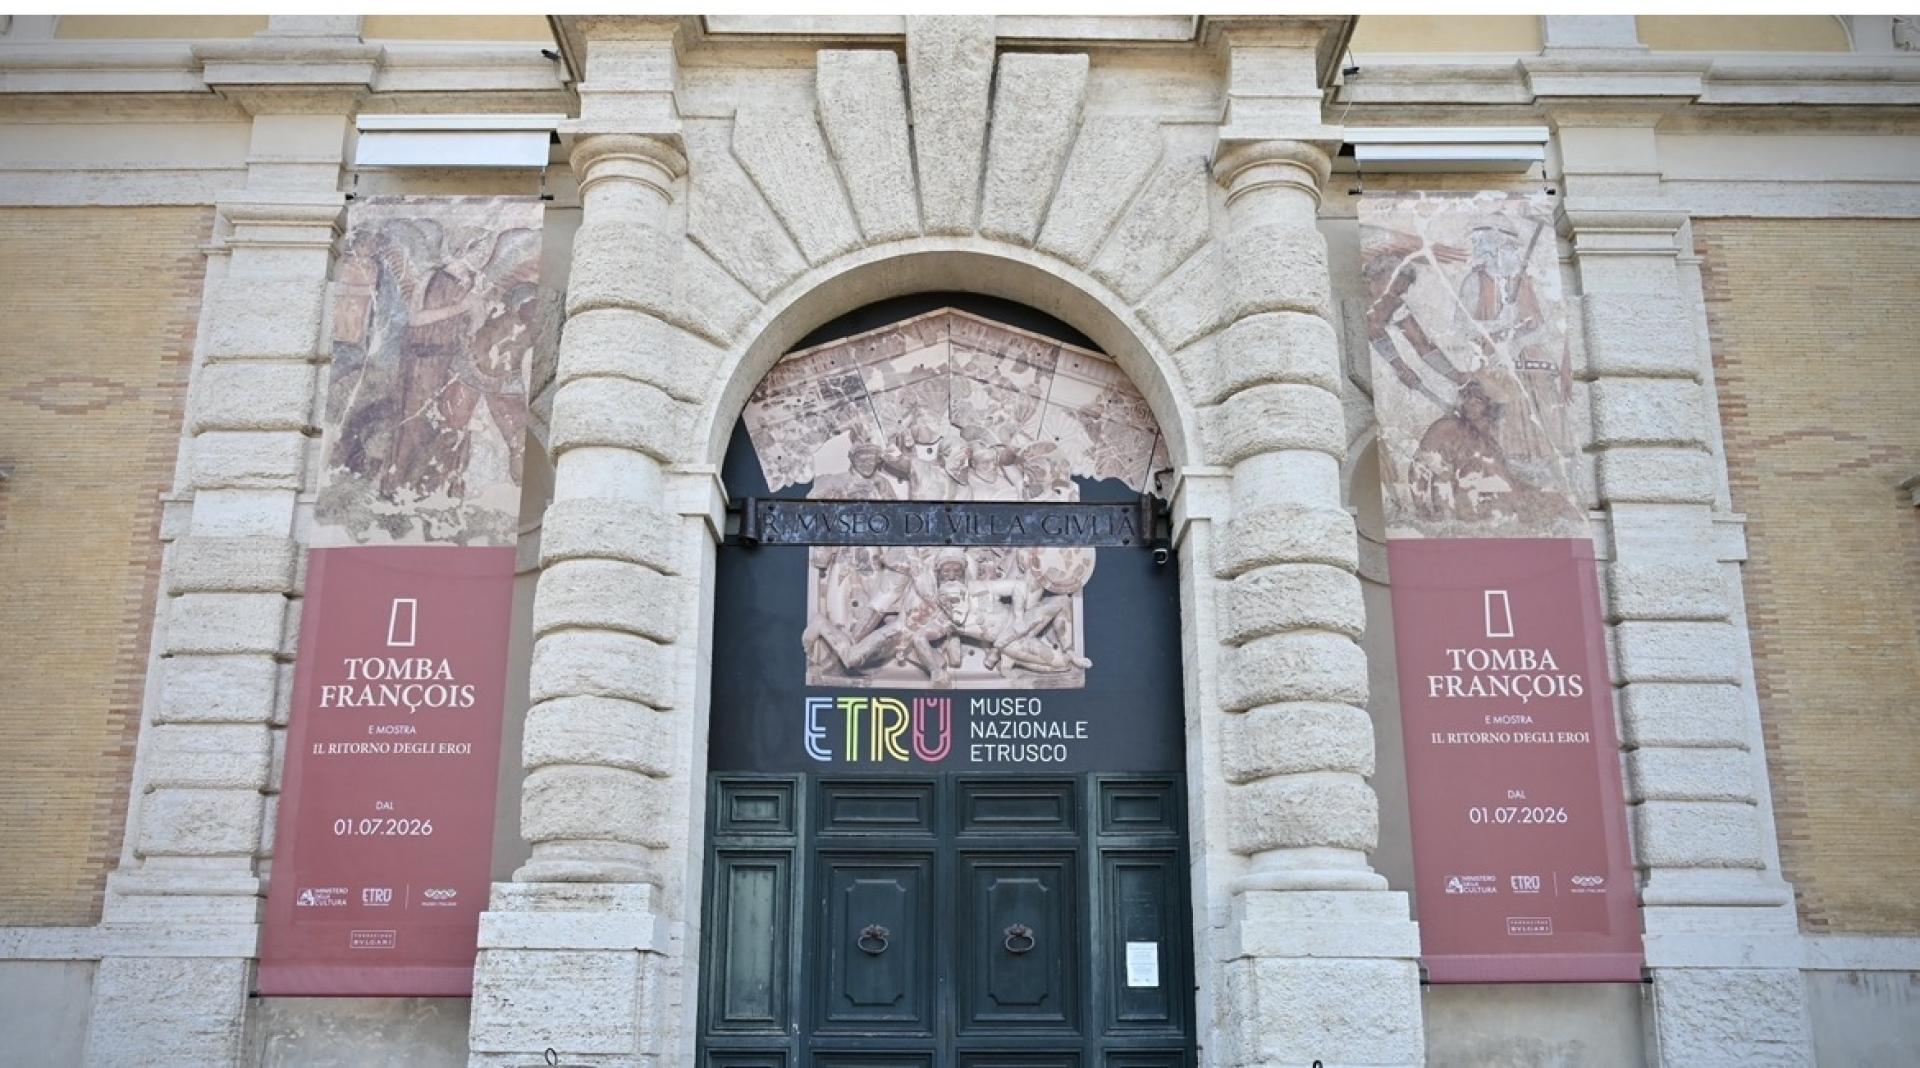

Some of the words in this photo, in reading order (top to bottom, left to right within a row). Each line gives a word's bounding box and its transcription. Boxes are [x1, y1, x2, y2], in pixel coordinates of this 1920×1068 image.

[797, 512, 890, 534] MVSEO
[904, 513, 930, 533] DI
[946, 514, 1025, 536] VILLA
[1041, 514, 1135, 536] GIVLIA
[343, 657, 454, 680] TOMBA
[1446, 648, 1559, 671] TOMBA
[1427, 674, 1584, 703] FRANÇOIS
[319, 684, 476, 713] FRANÇOIS
[970, 697, 1042, 716] MUSEO
[1485, 715, 1491, 724] E
[1493, 715, 1533, 724] MOSTRA
[368, 725, 374, 734] E
[375, 725, 417, 734] MOSTRA
[803, 696, 951, 763] ETRU
[970, 721, 1088, 739] NAZIONALE
[1431, 733, 1446, 744] IL
[1448, 732, 1511, 744] RITORNO
[1513, 732, 1554, 744] DEGLI
[1558, 732, 1590, 744] EROI
[312, 743, 326, 754] IL
[328, 743, 390, 754] RITORNO
[393, 743, 435, 754] DEGLI
[438, 743, 472, 754] EROI
[970, 744, 1068, 763] ETRUSCO
[1507, 789, 1526, 800] DAL
[375, 800, 394, 810] DAL
[1469, 806, 1568, 824] 01.07.2026
[334, 818, 433, 836] 01.07.2026
